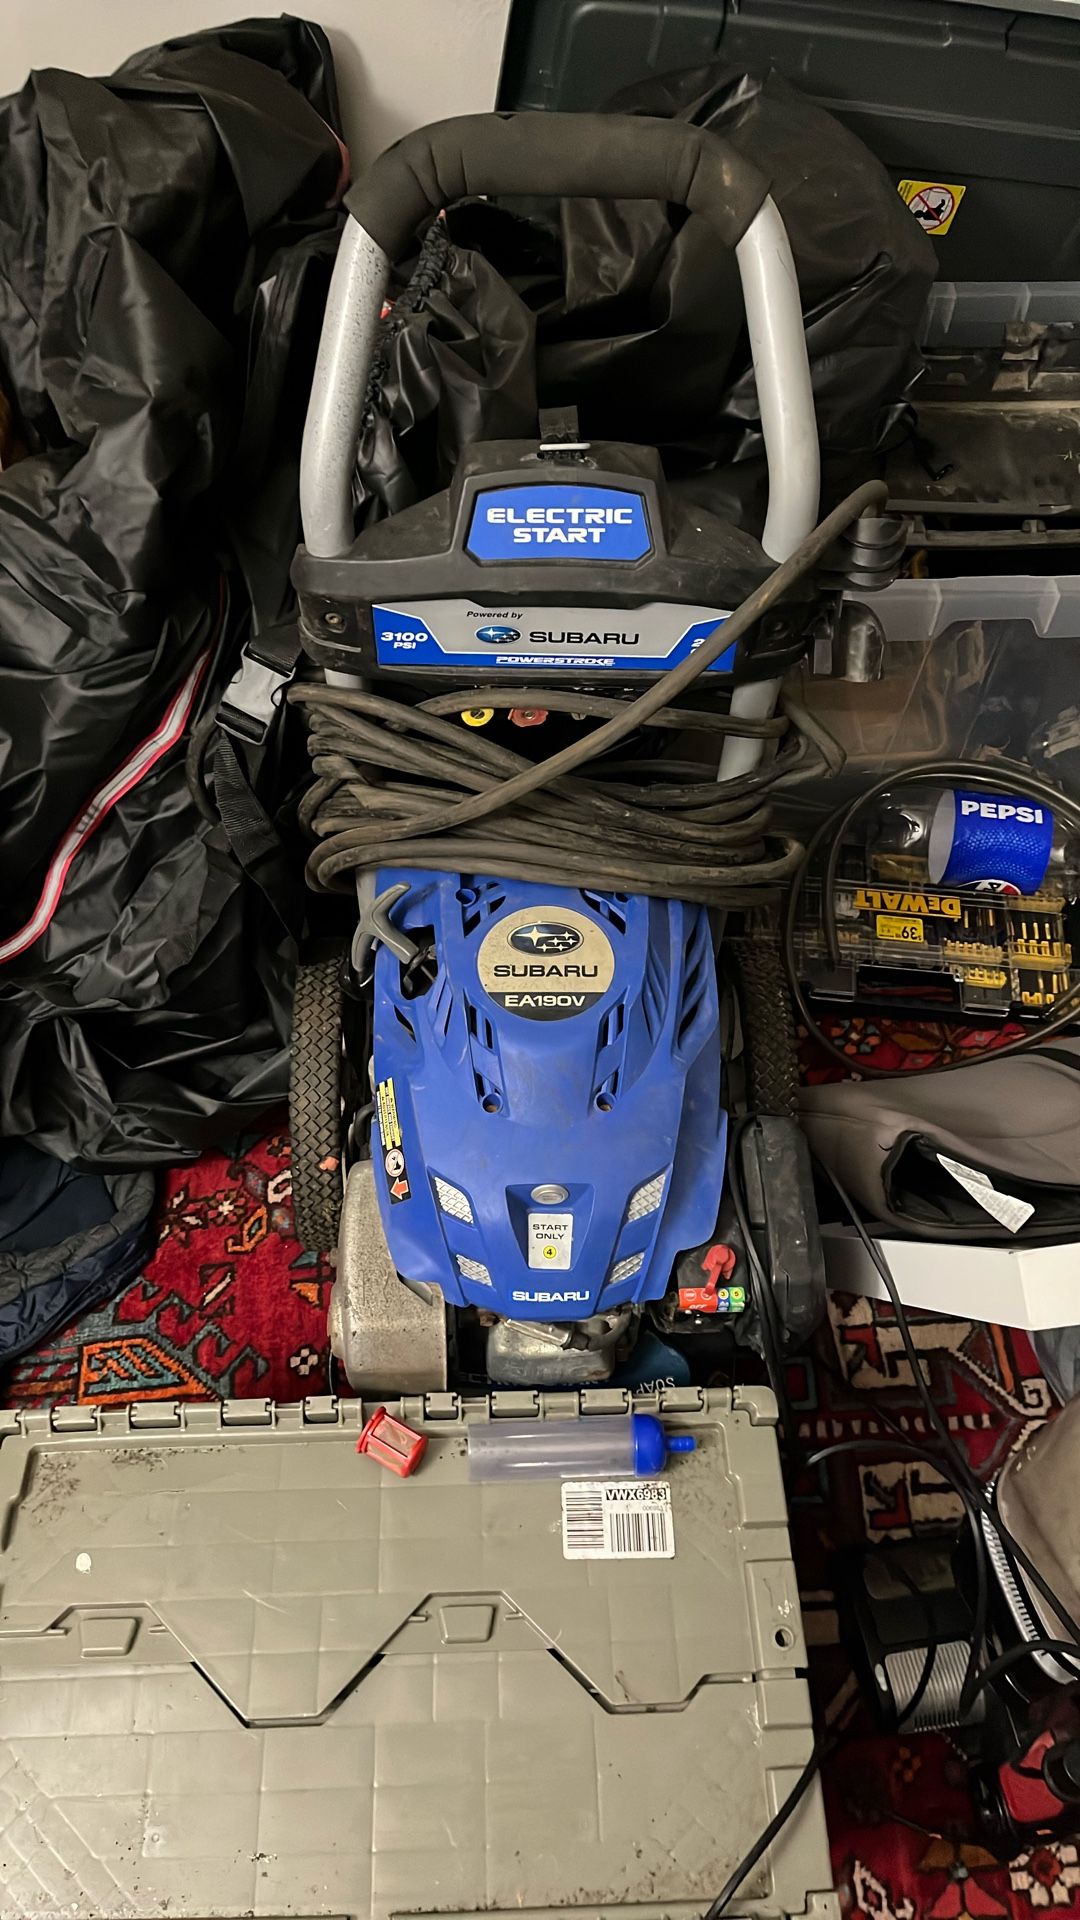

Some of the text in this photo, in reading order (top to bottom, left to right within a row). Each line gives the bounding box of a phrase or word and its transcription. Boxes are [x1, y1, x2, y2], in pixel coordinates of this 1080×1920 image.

[486, 508, 633, 524] ELECTRIC
[513, 528, 606, 543] START
[466, 611, 523, 620] Powered by
[381, 632, 428, 642] 3100
[529, 631, 640, 645] SUBARU
[496, 656, 615, 666] POWERSTROKE
[961, 800, 1044, 824] PEPSI
[493, 965, 598, 977] SUBARU
[504, 994, 585, 1007] EA190V
[512, 1291, 589, 1301] SUBARU
[606, 1488, 666, 1500] VWX6983
